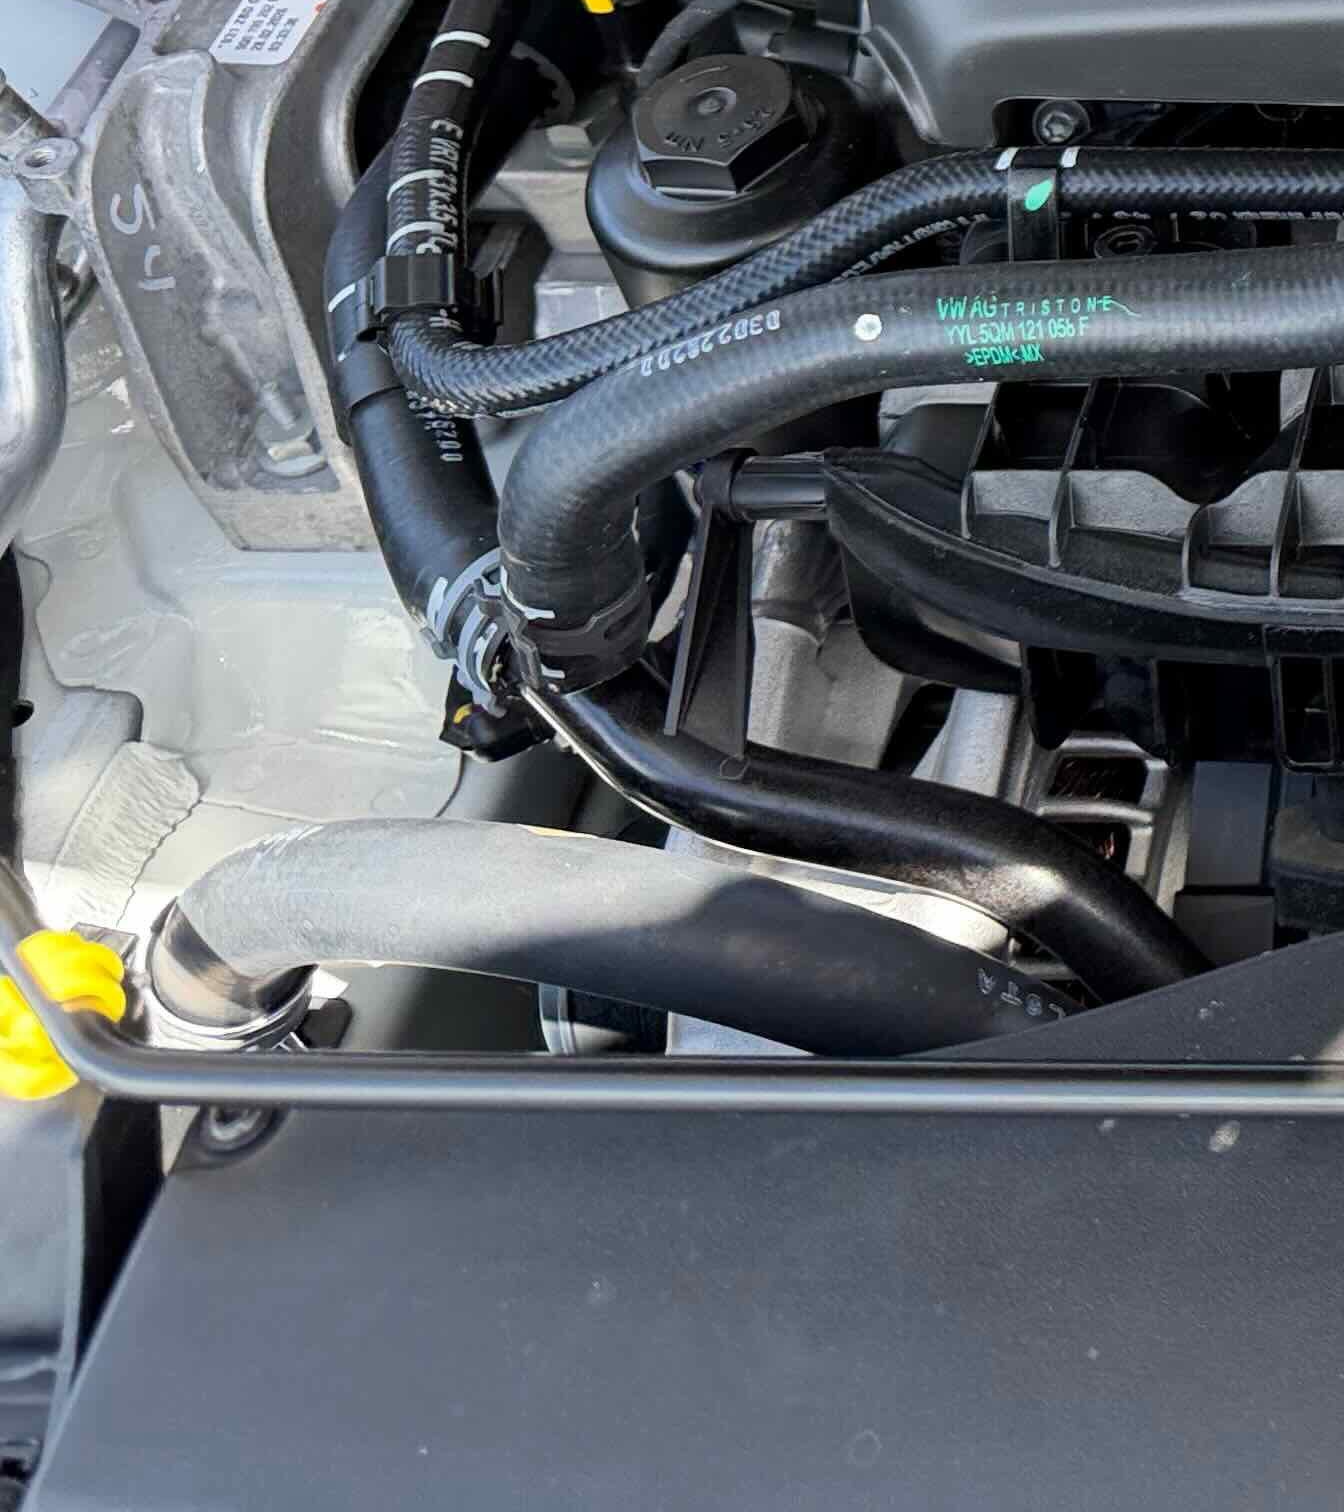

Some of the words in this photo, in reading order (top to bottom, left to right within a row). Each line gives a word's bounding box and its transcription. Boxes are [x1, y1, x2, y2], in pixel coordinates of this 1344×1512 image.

[936, 297, 967, 321] VW
[969, 296, 997, 319] AG
[1001, 295, 1113, 317] TRISTONE
[1019, 319, 1043, 340] 121
[1079, 316, 1089, 336] F
